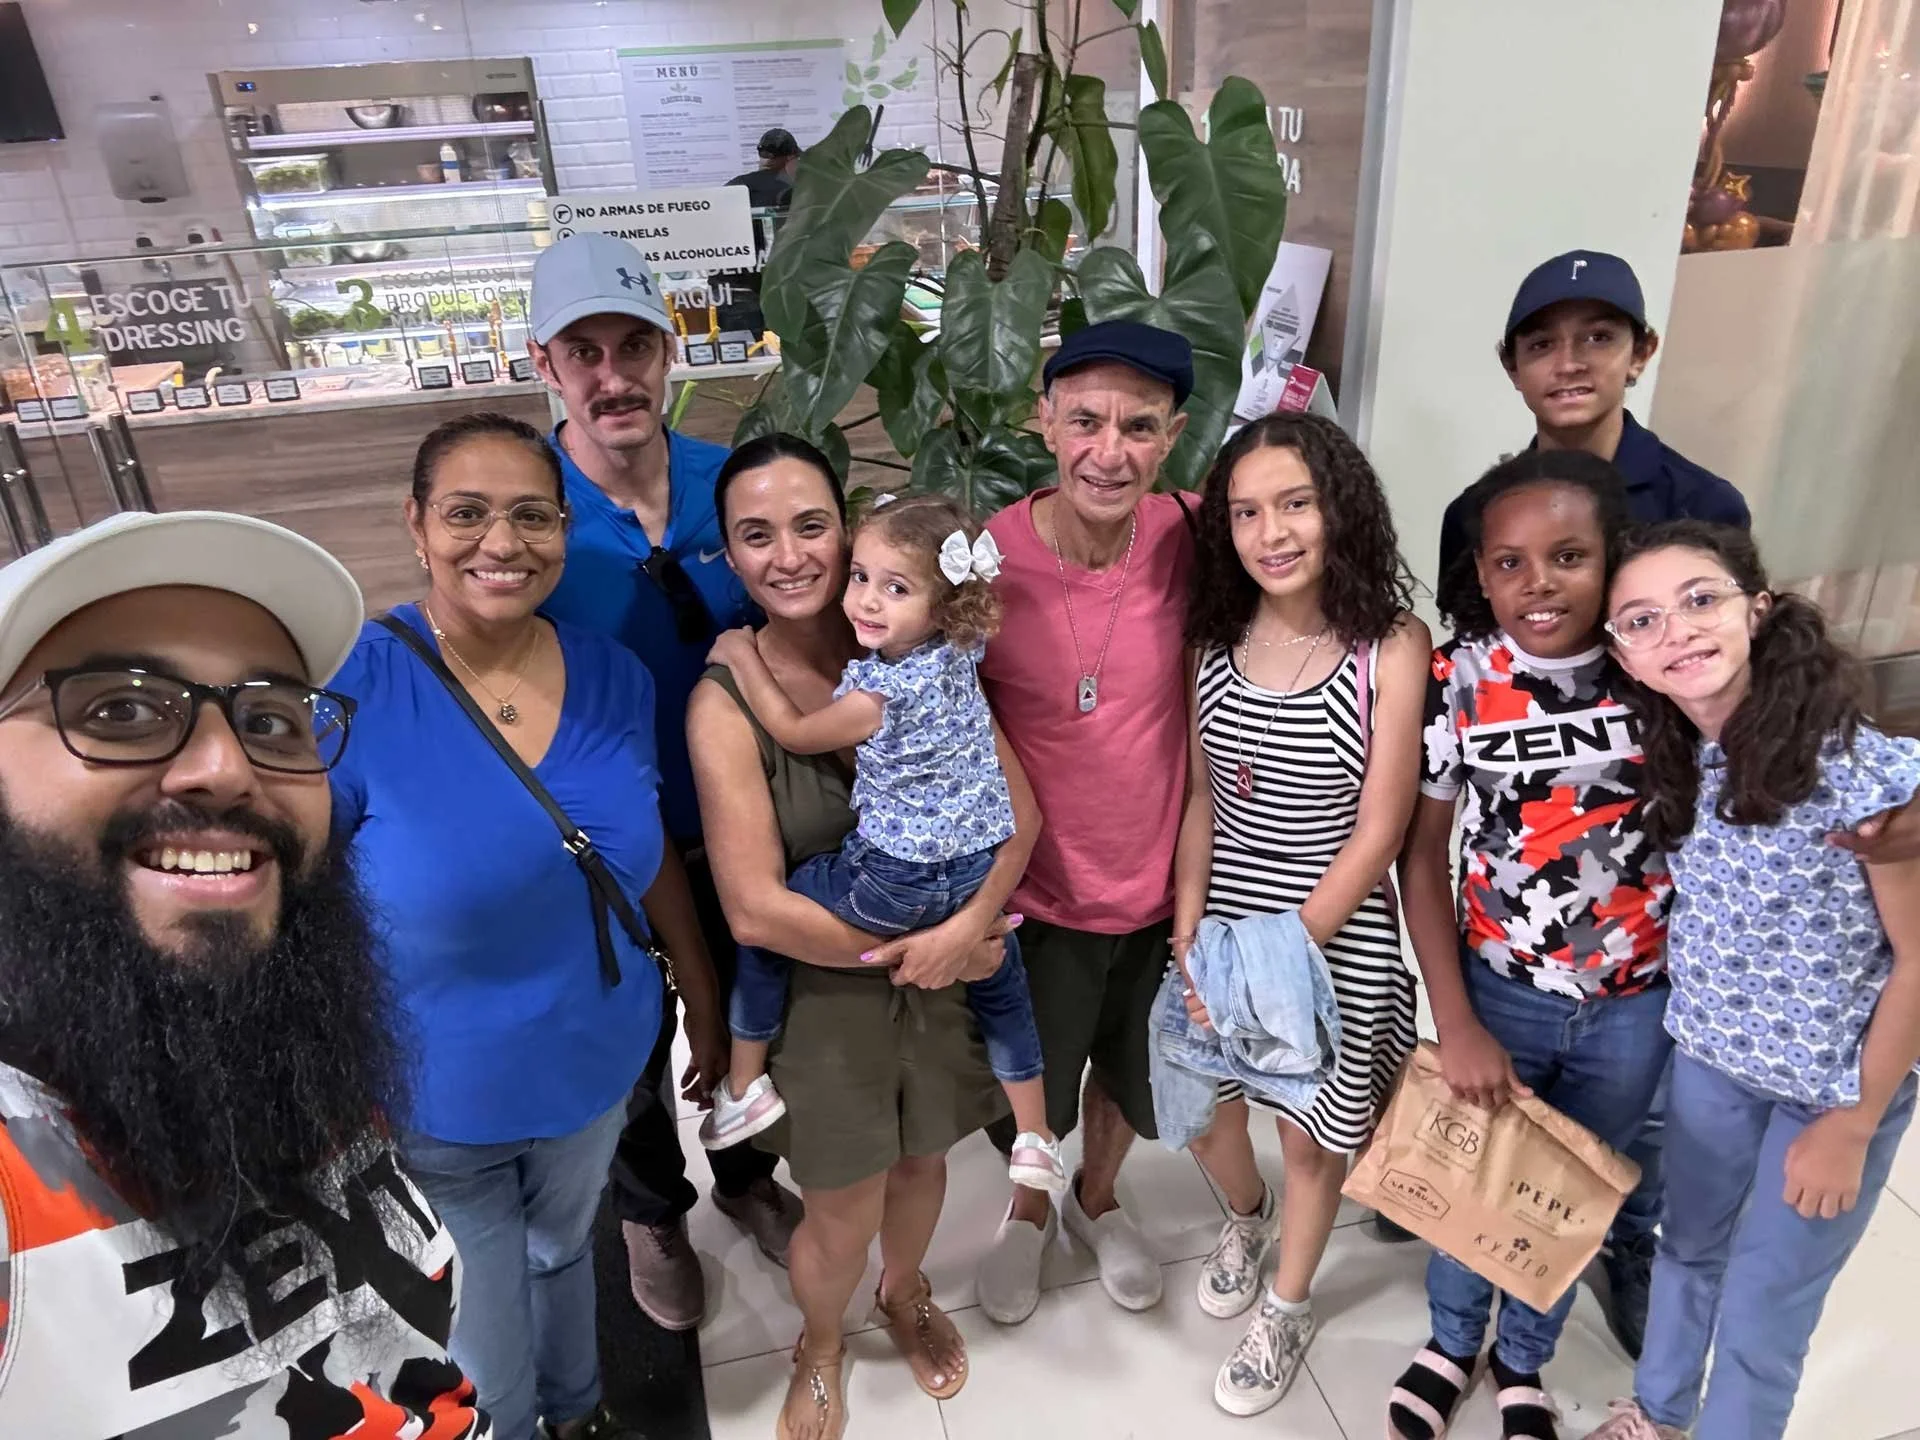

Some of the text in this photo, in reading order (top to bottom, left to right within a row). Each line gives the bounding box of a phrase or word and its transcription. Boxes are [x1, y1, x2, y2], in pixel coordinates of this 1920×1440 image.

[1278, 106, 1303, 143] TU
[576, 200, 711, 219] NO ARMAS DE FUEGO
[603, 227, 670, 239] RANELAS
[663, 245, 751, 262] ALCOHOLICAS
[91, 283, 251, 320] ESCOGE TU
[335, 278, 383, 332] 3
[385, 285, 508, 311] PRODUCTOS
[44, 298, 94, 351] 4
[102, 317, 247, 352] DRESSING
[1429, 1110, 1479, 1155] KGB
